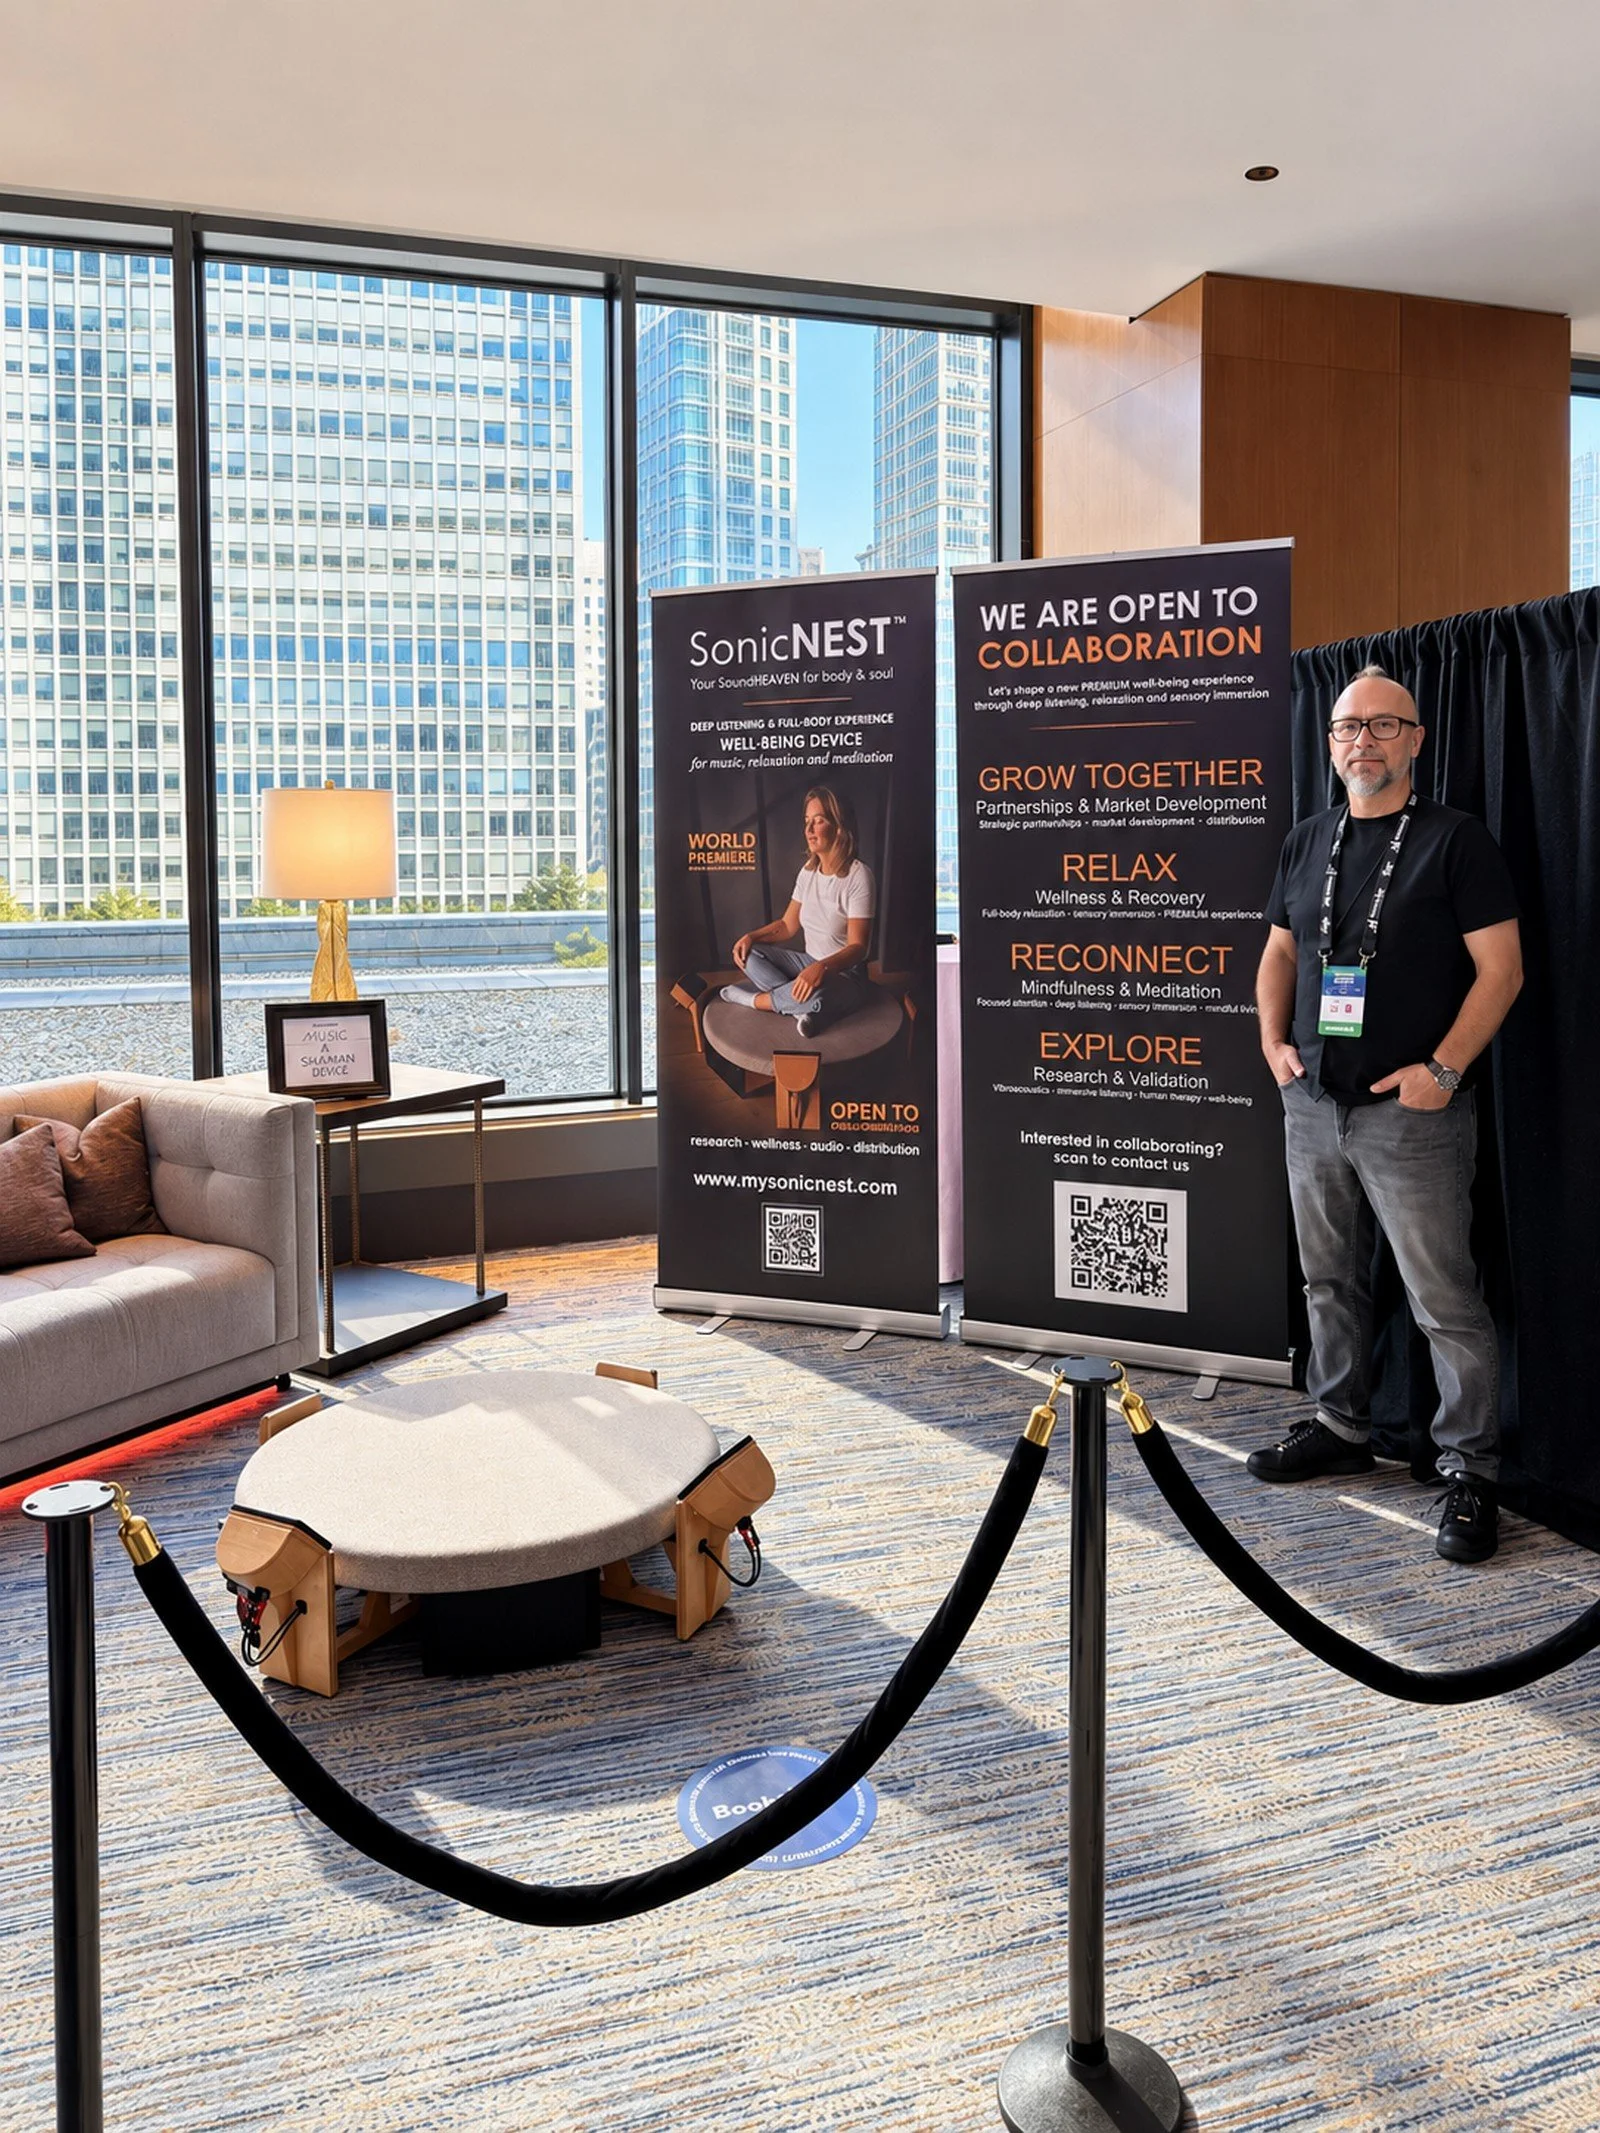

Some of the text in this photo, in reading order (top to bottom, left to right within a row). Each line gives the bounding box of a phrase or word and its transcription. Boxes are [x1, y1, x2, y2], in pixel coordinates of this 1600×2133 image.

[980, 585, 1258, 632] WE ARE OPEN TO
[977, 625, 1263, 670] COLLABORATION
[690, 667, 894, 690] Your SoundHEAVEN for body & soul
[1014, 686, 1045, 697] shape
[1056, 684, 1079, 693] new
[1081, 681, 1130, 692] PREMIUM
[974, 700, 1013, 712] through
[1015, 699, 1042, 710] deep
[1146, 692, 1168, 703] and
[690, 721, 715, 732] DEEP
[716, 719, 765, 731] LISTENING
[778, 716, 832, 729] FULL-BODY
[834, 713, 894, 726] EXPERIENCE
[720, 732, 863, 751] WELL-BEING DEVICE
[688, 751, 893, 772] for music, relaxation and meditation
[978, 758, 1264, 792] GROW TOGETHER
[976, 795, 1267, 817] Partnerships & Market Development
[688, 832, 756, 849] WORLD
[688, 851, 756, 863] PREMIERE
[1062, 852, 1178, 883] RELAX
[1035, 889, 1206, 909] Wellness & Recovery
[1011, 942, 1233, 975] RECONNECT
[1021, 980, 1221, 999] Mindfulness & Meditation
[302, 1029, 348, 1042] MUSIC
[1040, 1031, 1203, 1067] EXPLORE
[301, 1054, 355, 1067] SHAMAN
[312, 1065, 349, 1077] DEVICE
[1033, 1066, 1209, 1089] Research & Validation
[830, 1102, 919, 1122] OPEN TO
[690, 1136, 920, 1156] research wellness audio distribution
[1020, 1130, 1224, 1158] Interested in collaborating?
[1053, 1152, 1190, 1172] scan to contact us
[693, 1172, 898, 1195] www.mysonicnest.com
